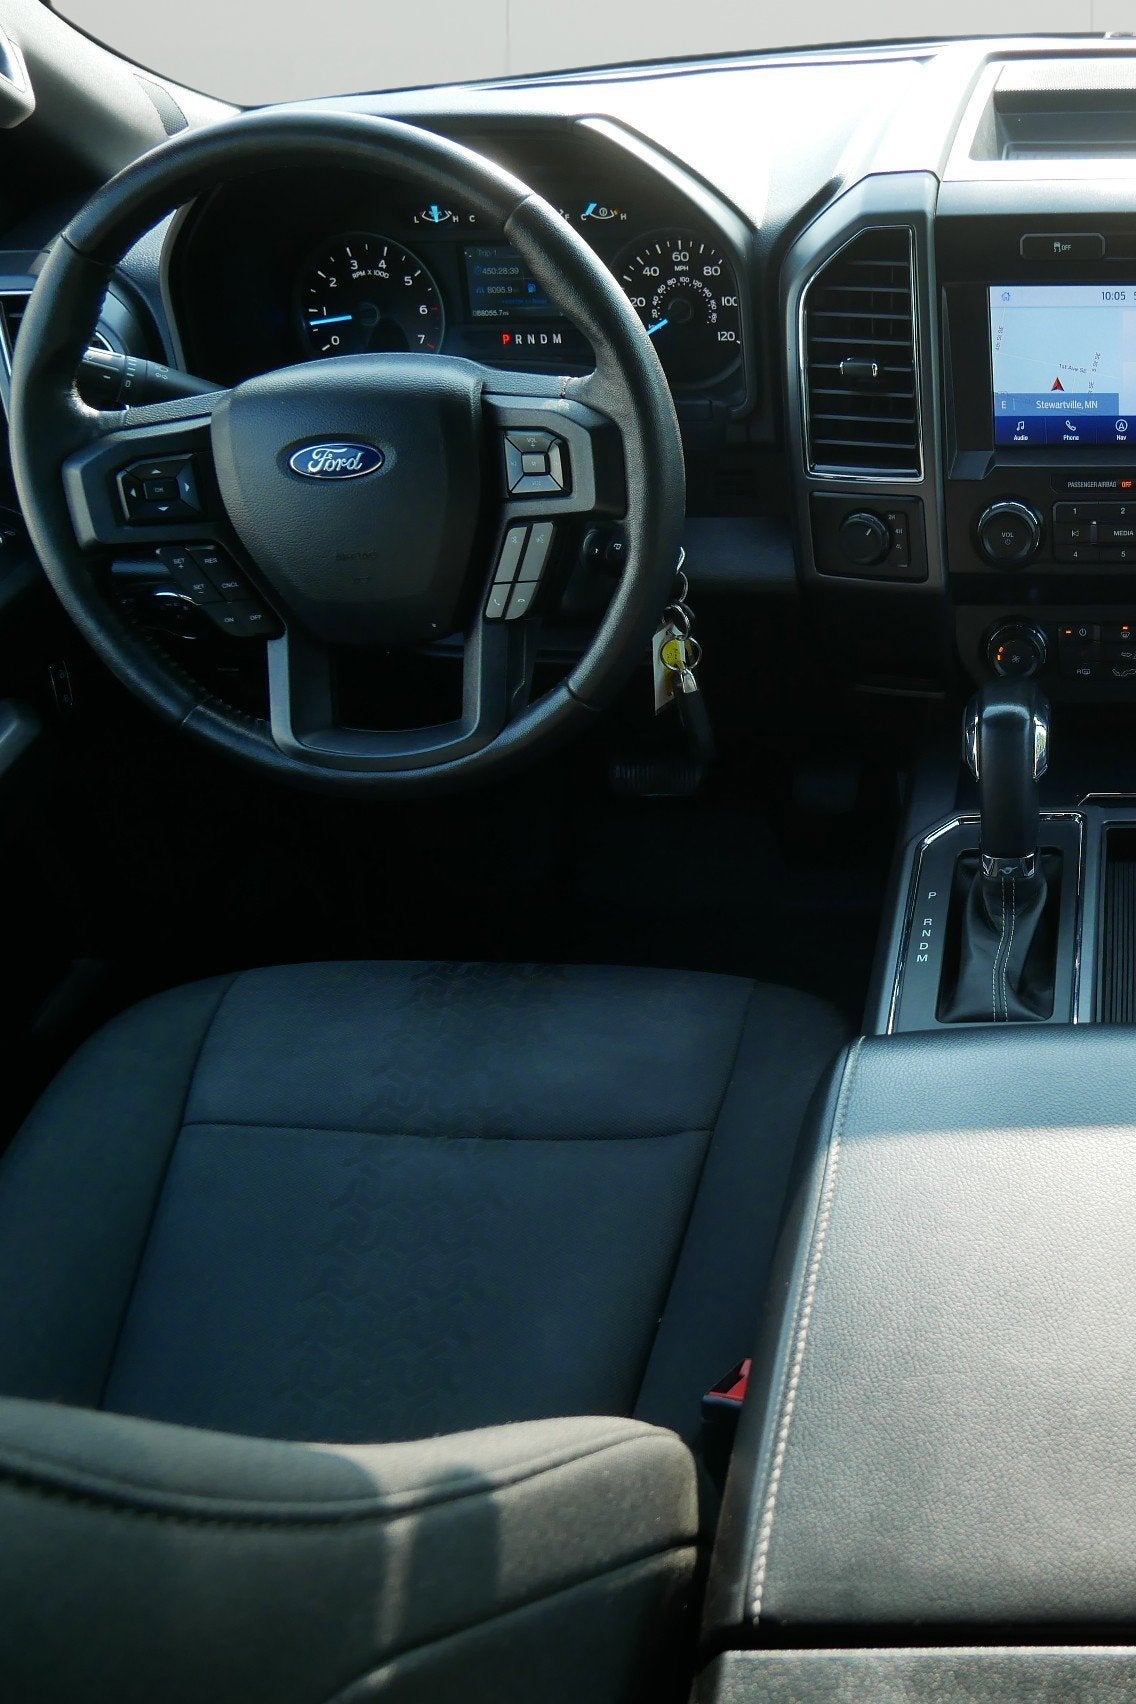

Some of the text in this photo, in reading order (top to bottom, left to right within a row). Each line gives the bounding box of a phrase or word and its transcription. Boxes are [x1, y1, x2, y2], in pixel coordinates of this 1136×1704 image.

[672, 252, 690, 262] 60
[350, 260, 358, 270] 3
[378, 260, 387, 269] 4
[352, 270, 366, 279] RPM
[374, 270, 390, 278] 1000
[642, 266, 660, 276] 40
[703, 266, 720, 276] 80
[330, 278, 338, 288] 2
[404, 276, 412, 286] 5
[667, 278, 676, 286] 80
[692, 280, 702, 288] 120
[658, 284, 666, 294] 60
[652, 296, 659, 306] 40
[1102, 291, 1126, 301] 10:05
[630, 297, 646, 307] 20
[419, 305, 428, 314] 6
[652, 308, 658, 318] 20
[331, 336, 340, 346] 0
[418, 335, 425, 344] 7
[502, 334, 562, 344] P R N D M
[718, 332, 736, 341] 120
[1002, 401, 1006, 409] E
[1036, 400, 1098, 410] Stewartville, MN
[308, 447, 365, 472] Ford
[928, 891, 937, 899] P
[916, 954, 928, 962] M
